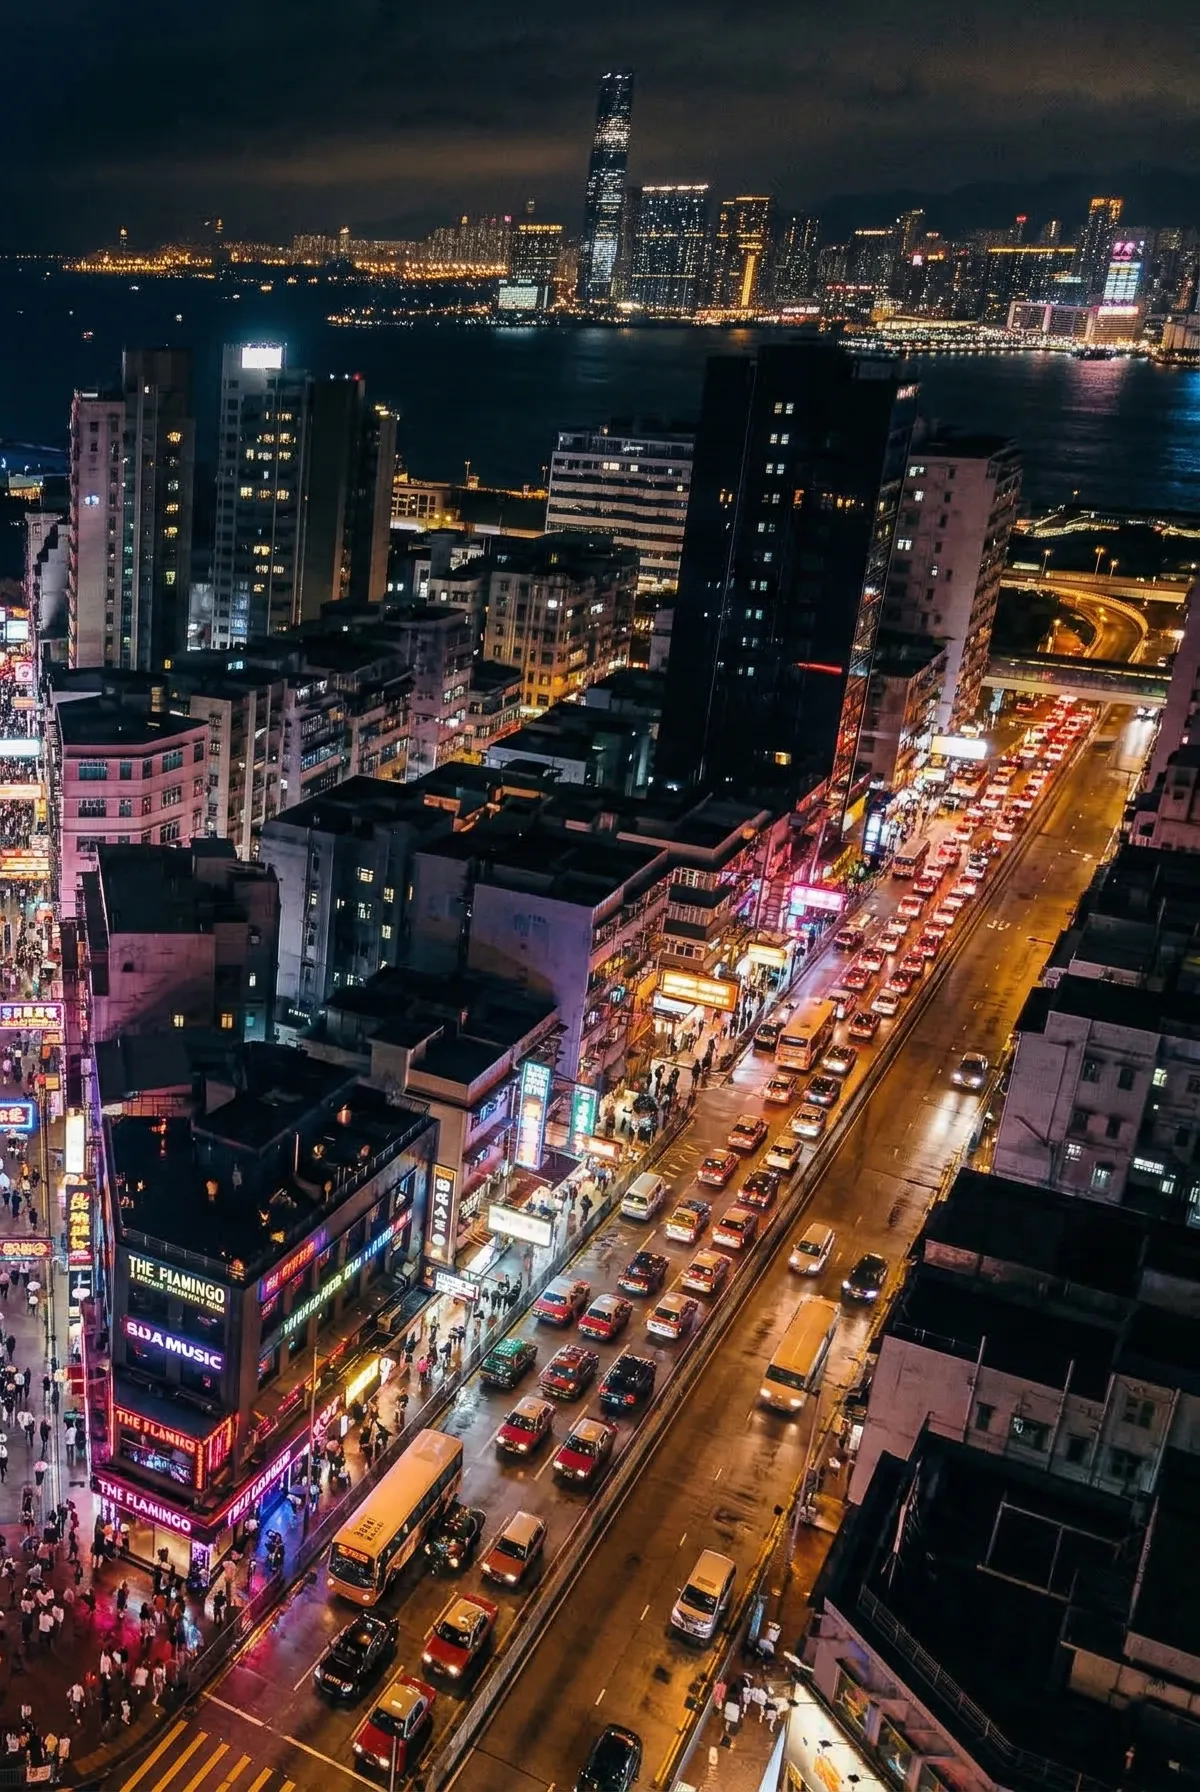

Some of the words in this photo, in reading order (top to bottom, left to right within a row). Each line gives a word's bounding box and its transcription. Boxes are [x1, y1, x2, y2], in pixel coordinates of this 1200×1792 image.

[128, 1254, 154, 1277] THE
[165, 1336, 222, 1370] MUSIC
[116, 1410, 140, 1428] THE
[126, 1492, 191, 1532] FLAMINGO
